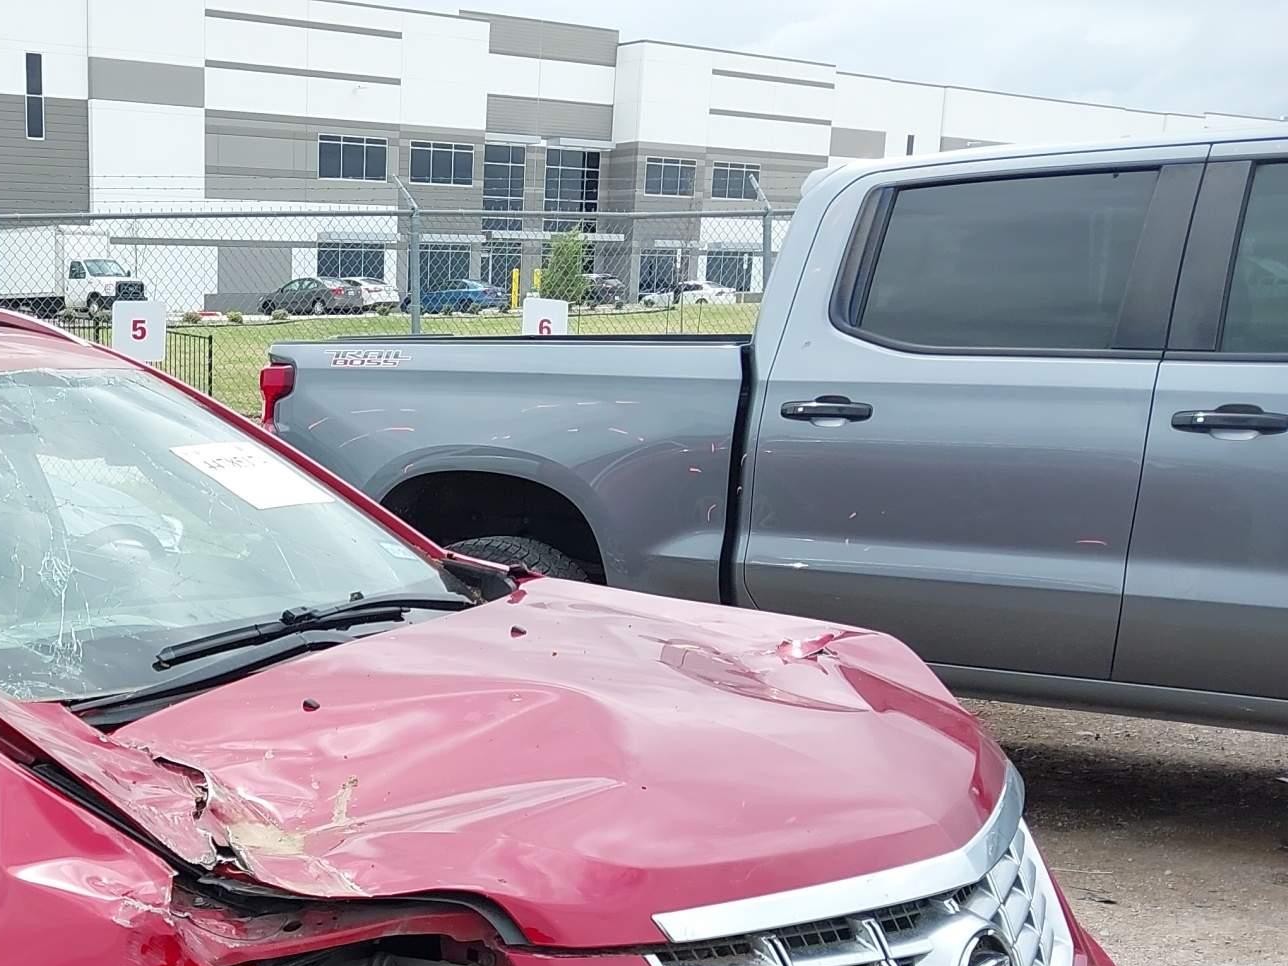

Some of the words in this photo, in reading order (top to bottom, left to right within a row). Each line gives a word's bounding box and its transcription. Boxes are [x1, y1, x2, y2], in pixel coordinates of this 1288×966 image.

[131, 319, 147, 341] 5
[538, 318, 552, 336] 6
[324, 349, 412, 361] TRAIL
[330, 359, 401, 368] BOSS
